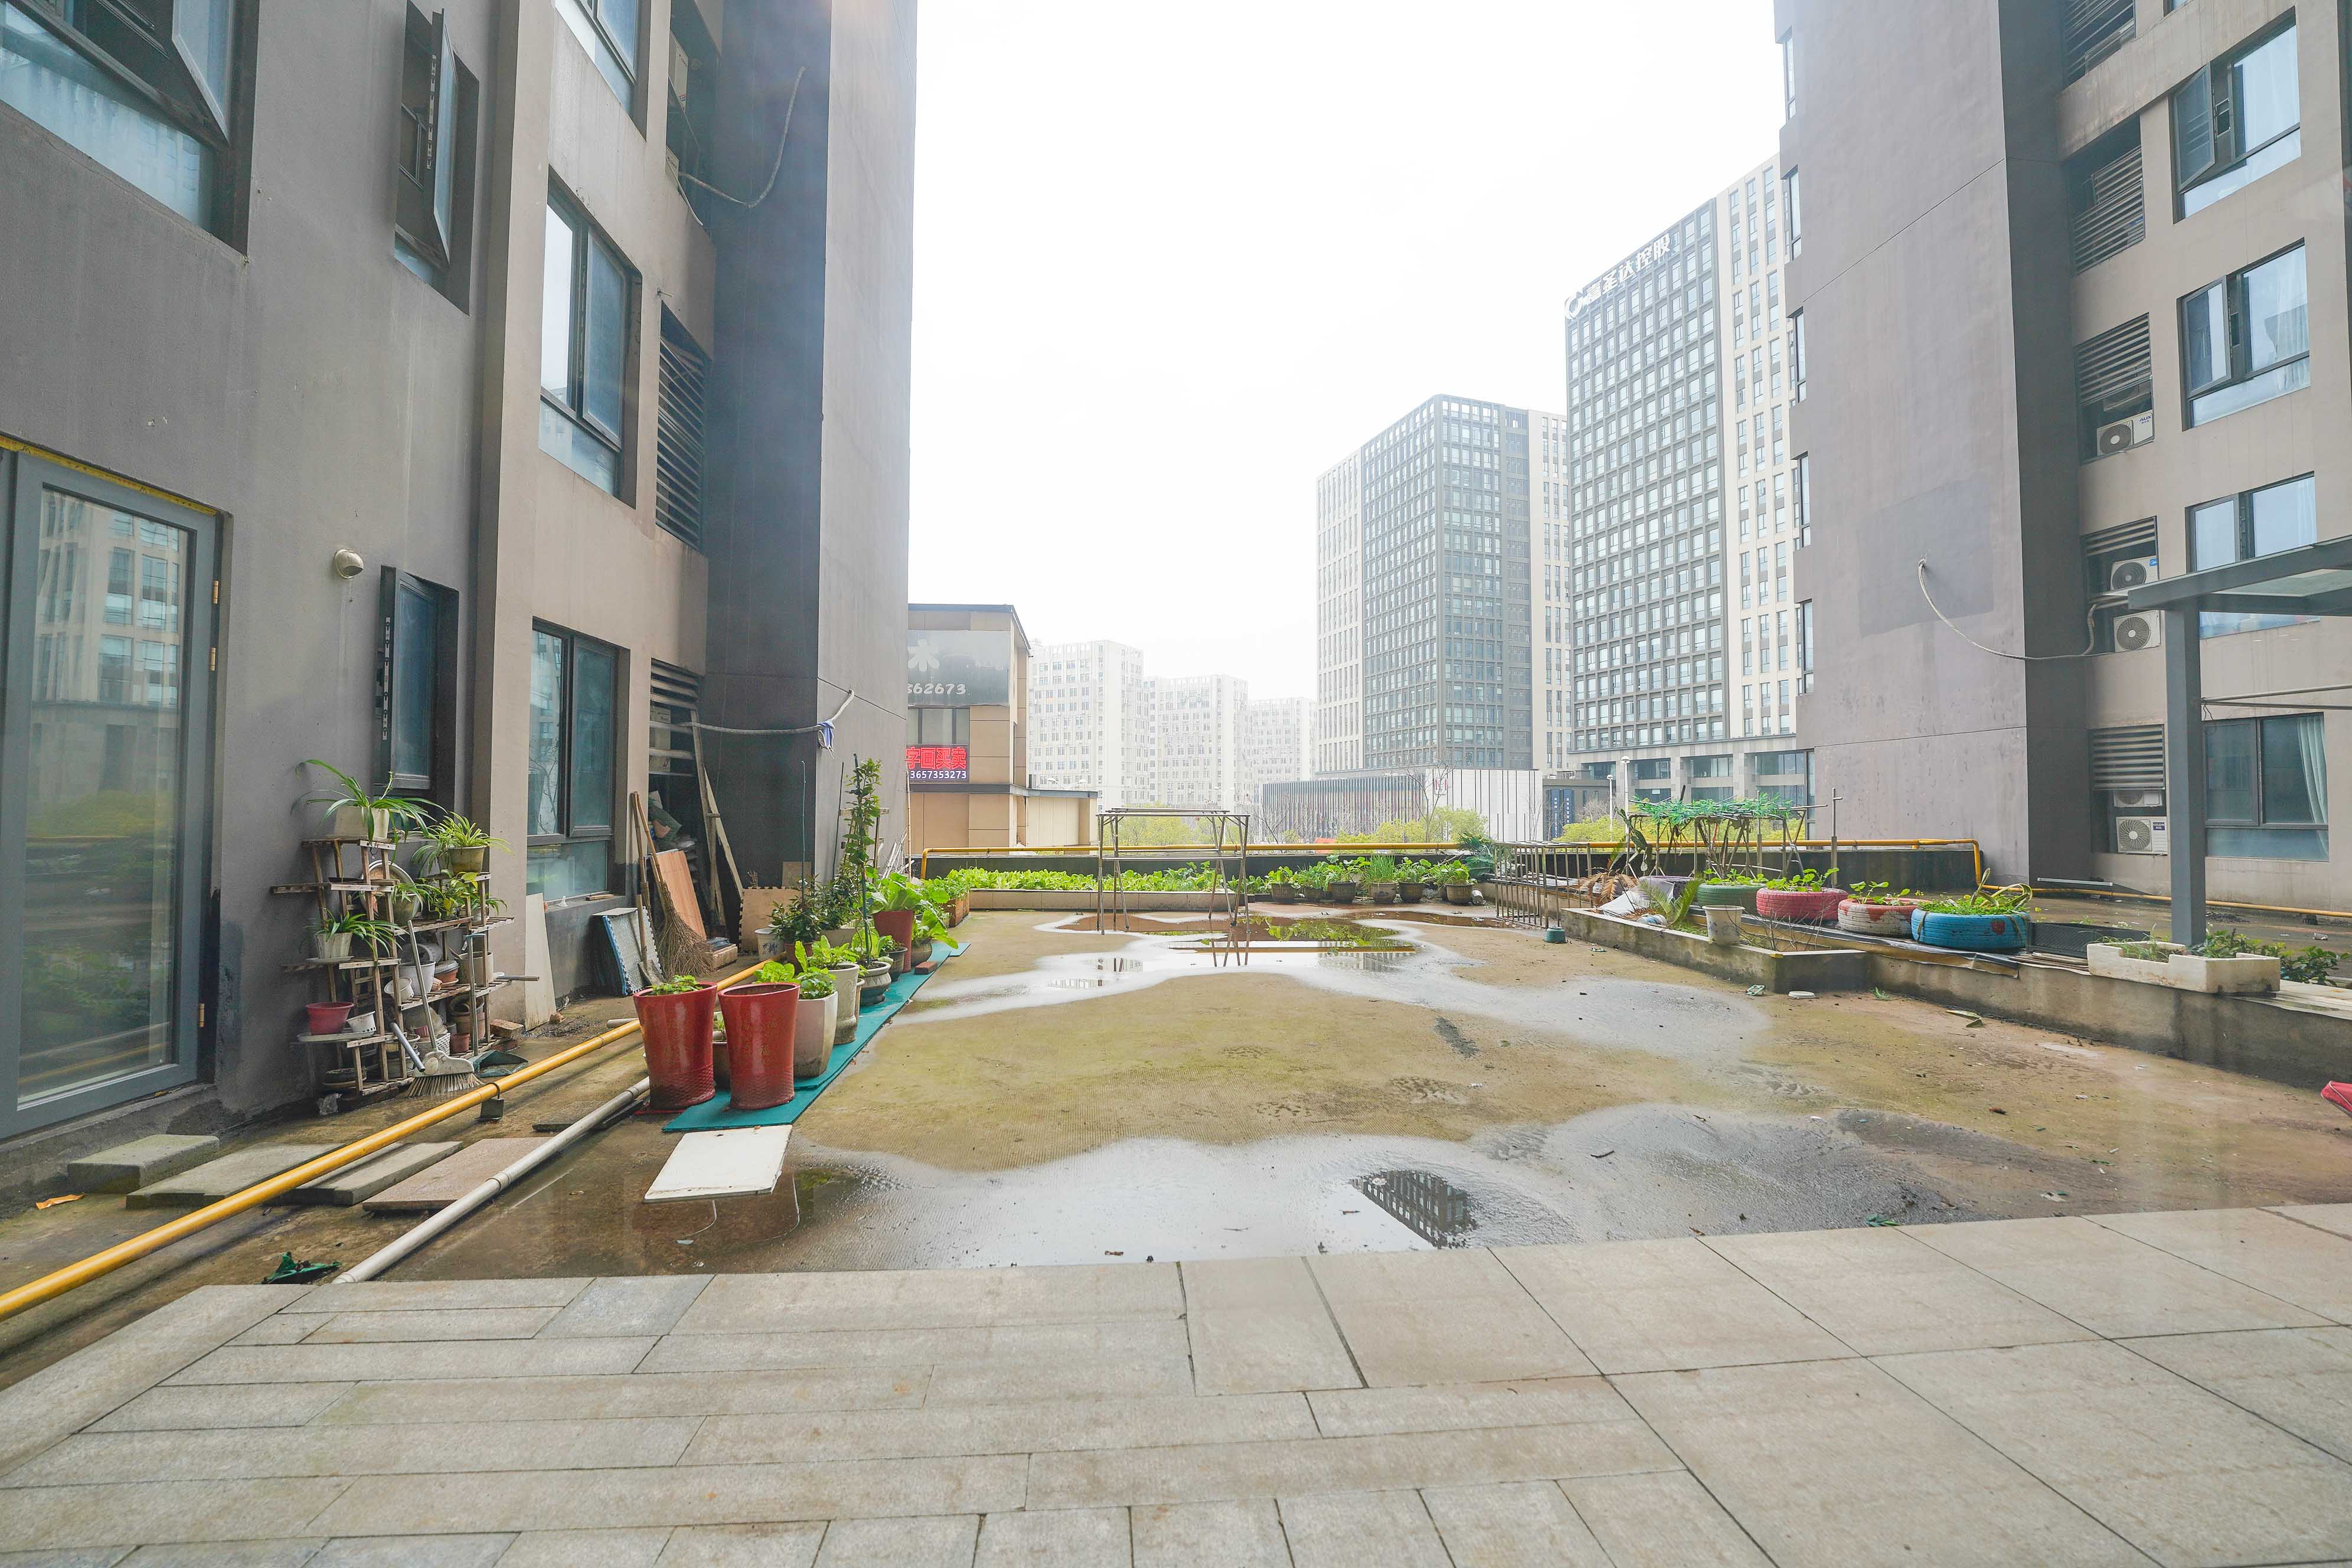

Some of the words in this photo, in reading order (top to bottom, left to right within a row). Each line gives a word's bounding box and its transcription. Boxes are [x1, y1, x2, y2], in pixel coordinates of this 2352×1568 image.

[906, 746, 966, 770] 字画买卖
[910, 770, 967, 779] 3657353273
